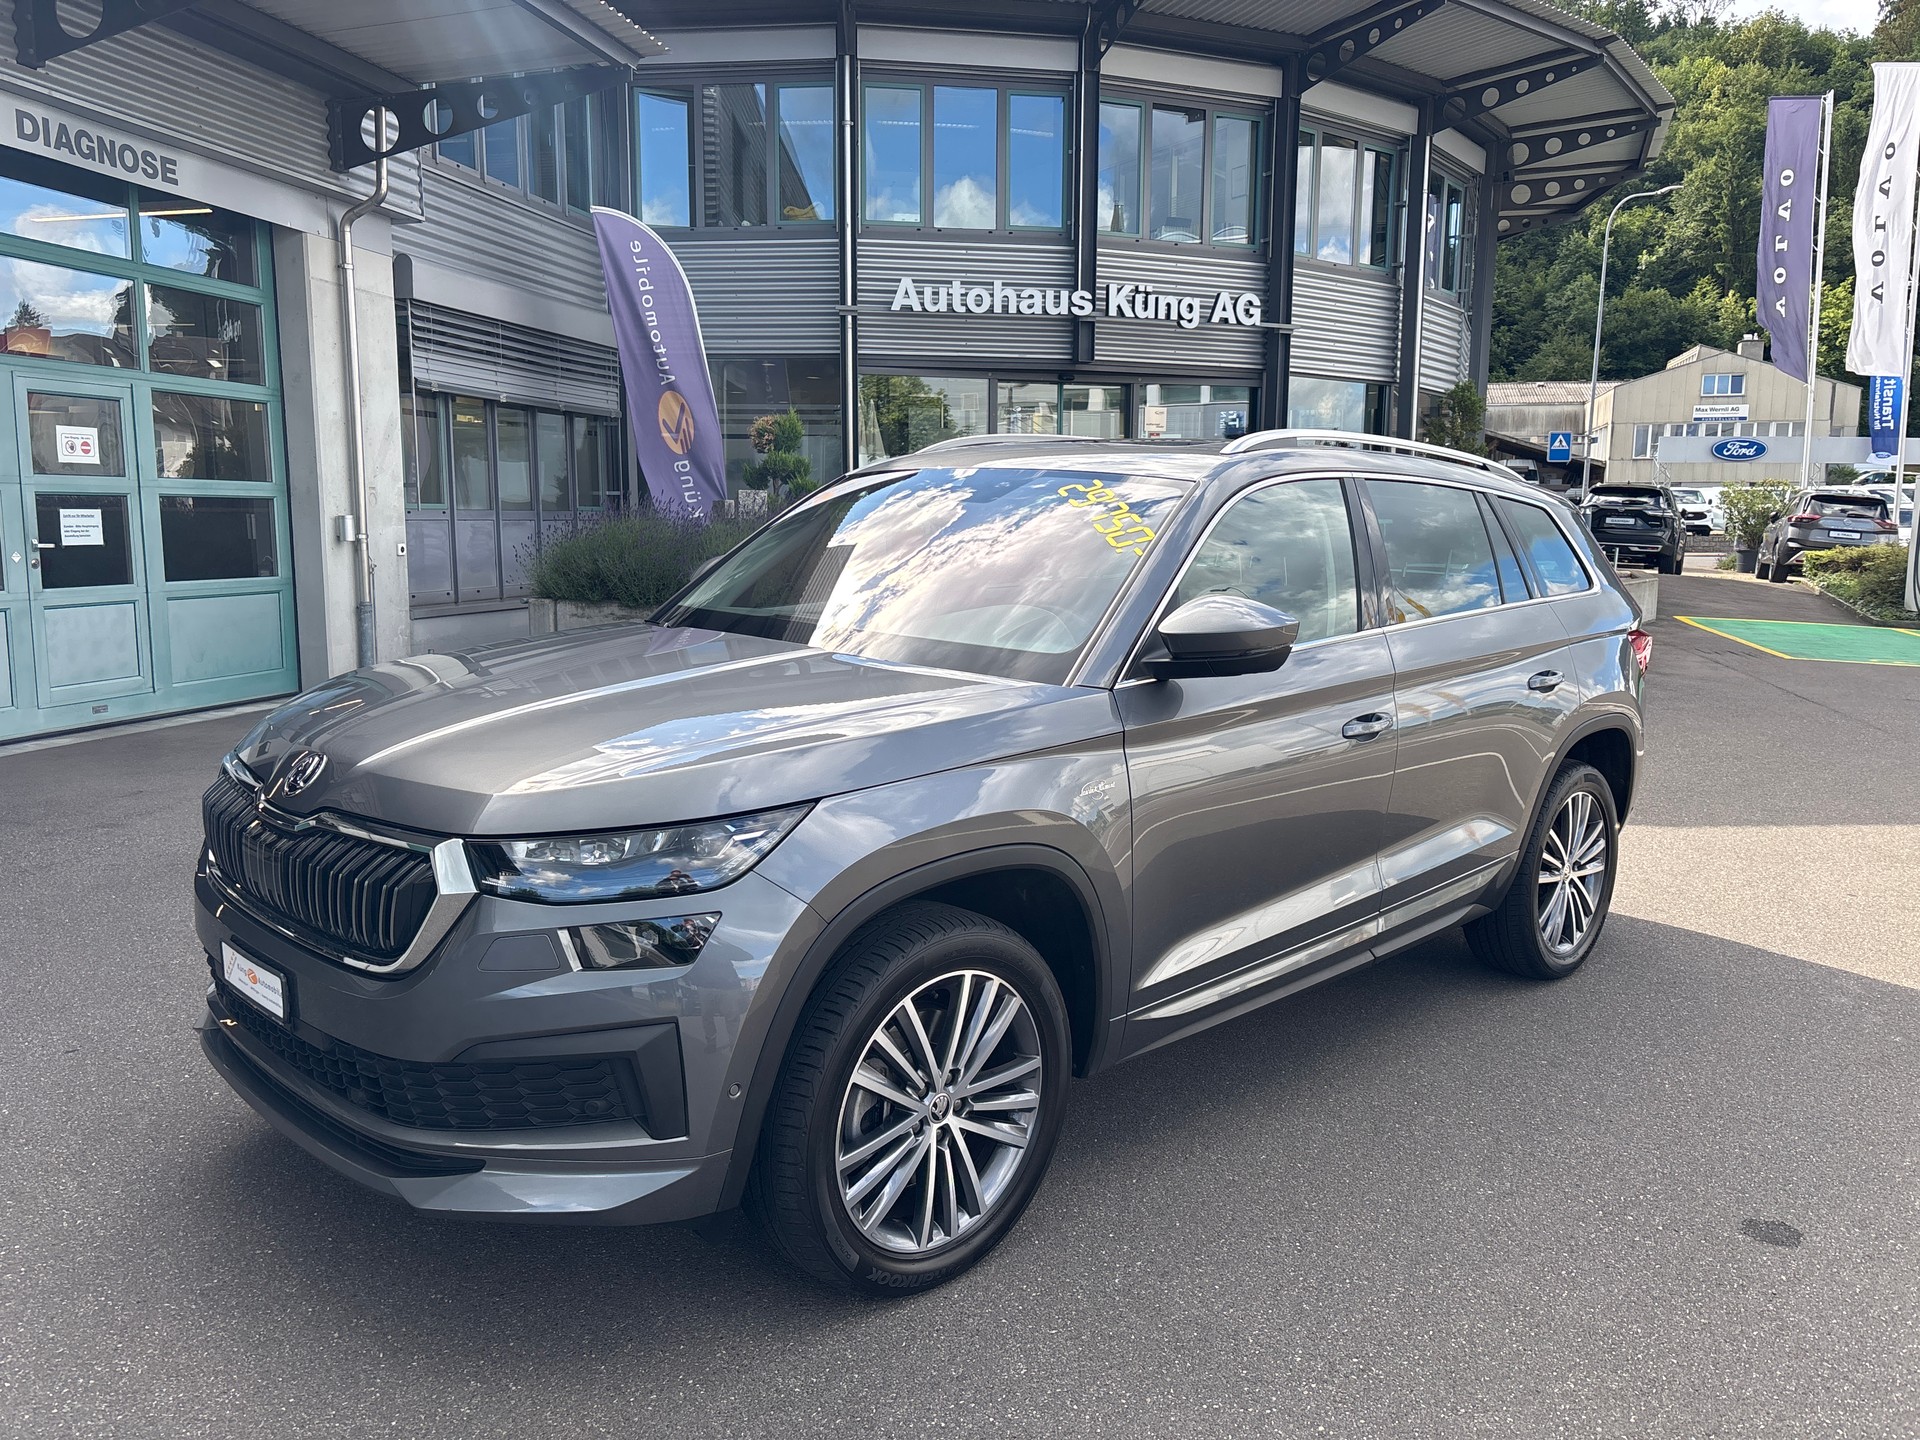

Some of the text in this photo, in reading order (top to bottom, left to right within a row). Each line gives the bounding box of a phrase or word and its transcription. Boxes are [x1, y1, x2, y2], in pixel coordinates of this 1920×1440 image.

[15, 108, 179, 186] DIAGNOSE
[890, 277, 1262, 330] Autohaus Küng AG
[1722, 441, 1758, 456] Ford
